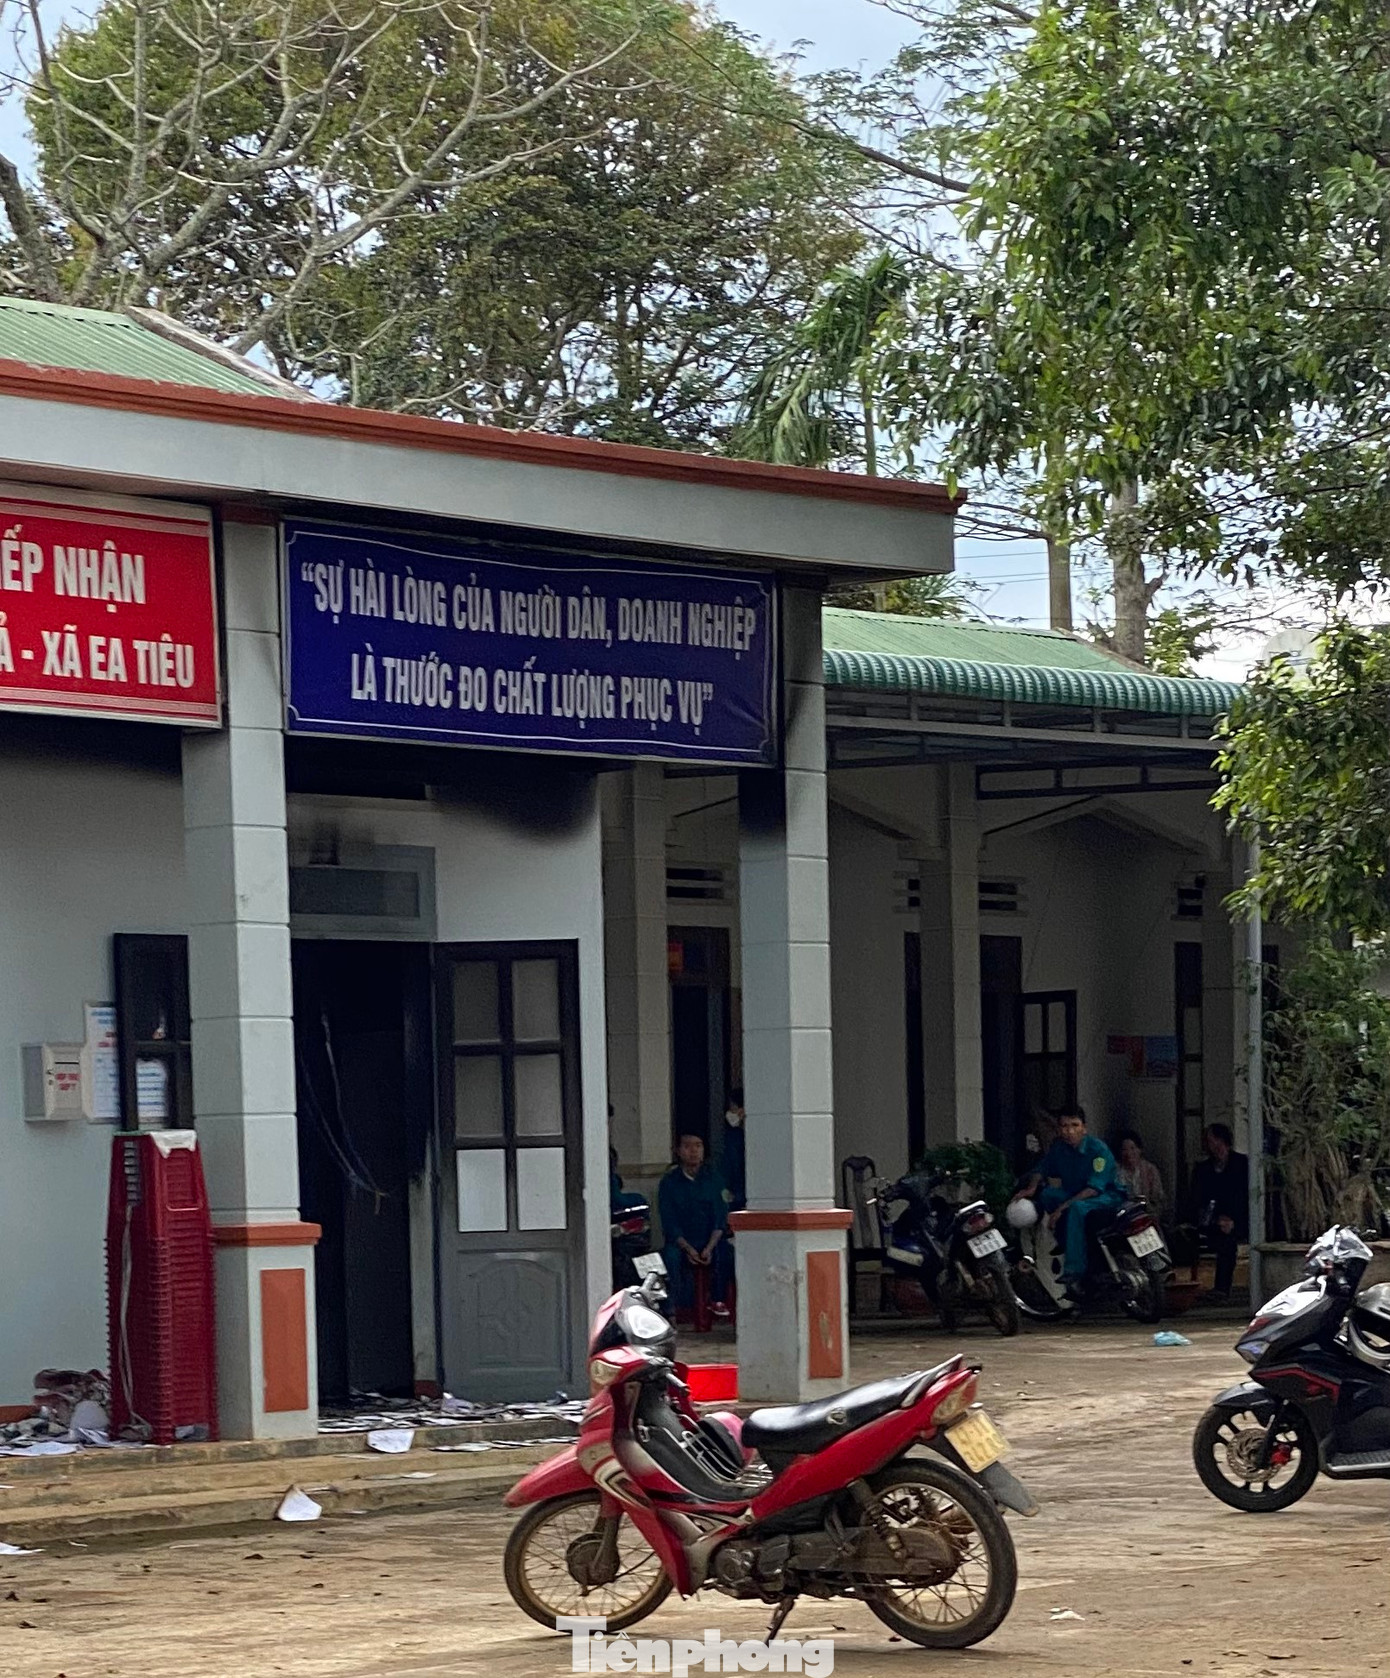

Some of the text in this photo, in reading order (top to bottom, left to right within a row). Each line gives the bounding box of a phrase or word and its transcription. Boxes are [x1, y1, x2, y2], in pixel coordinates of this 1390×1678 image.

[53, 539, 147, 613] NHẬN
[349, 557, 387, 618] HÀI
[392, 565, 447, 627] LÒNG
[452, 572, 495, 633] CỦA
[500, 584, 562, 638] NGƯỜI
[567, 585, 612, 648] DÂN,
[618, 597, 683, 644] DOANH
[688, 595, 756, 661] NGHIỆP
[41, 624, 83, 678] XÃ
[88, 635, 128, 682] EA
[132, 632, 195, 688] TIÊU
[351, 642, 377, 701] LÀ
[382, 651, 453, 709] THƯỚC
[458, 665, 488, 712] ĐO
[493, 655, 547, 715] CHẤT
[551, 668, 615, 729] LƯỢNG
[620, 676, 673, 731] PHỤC
